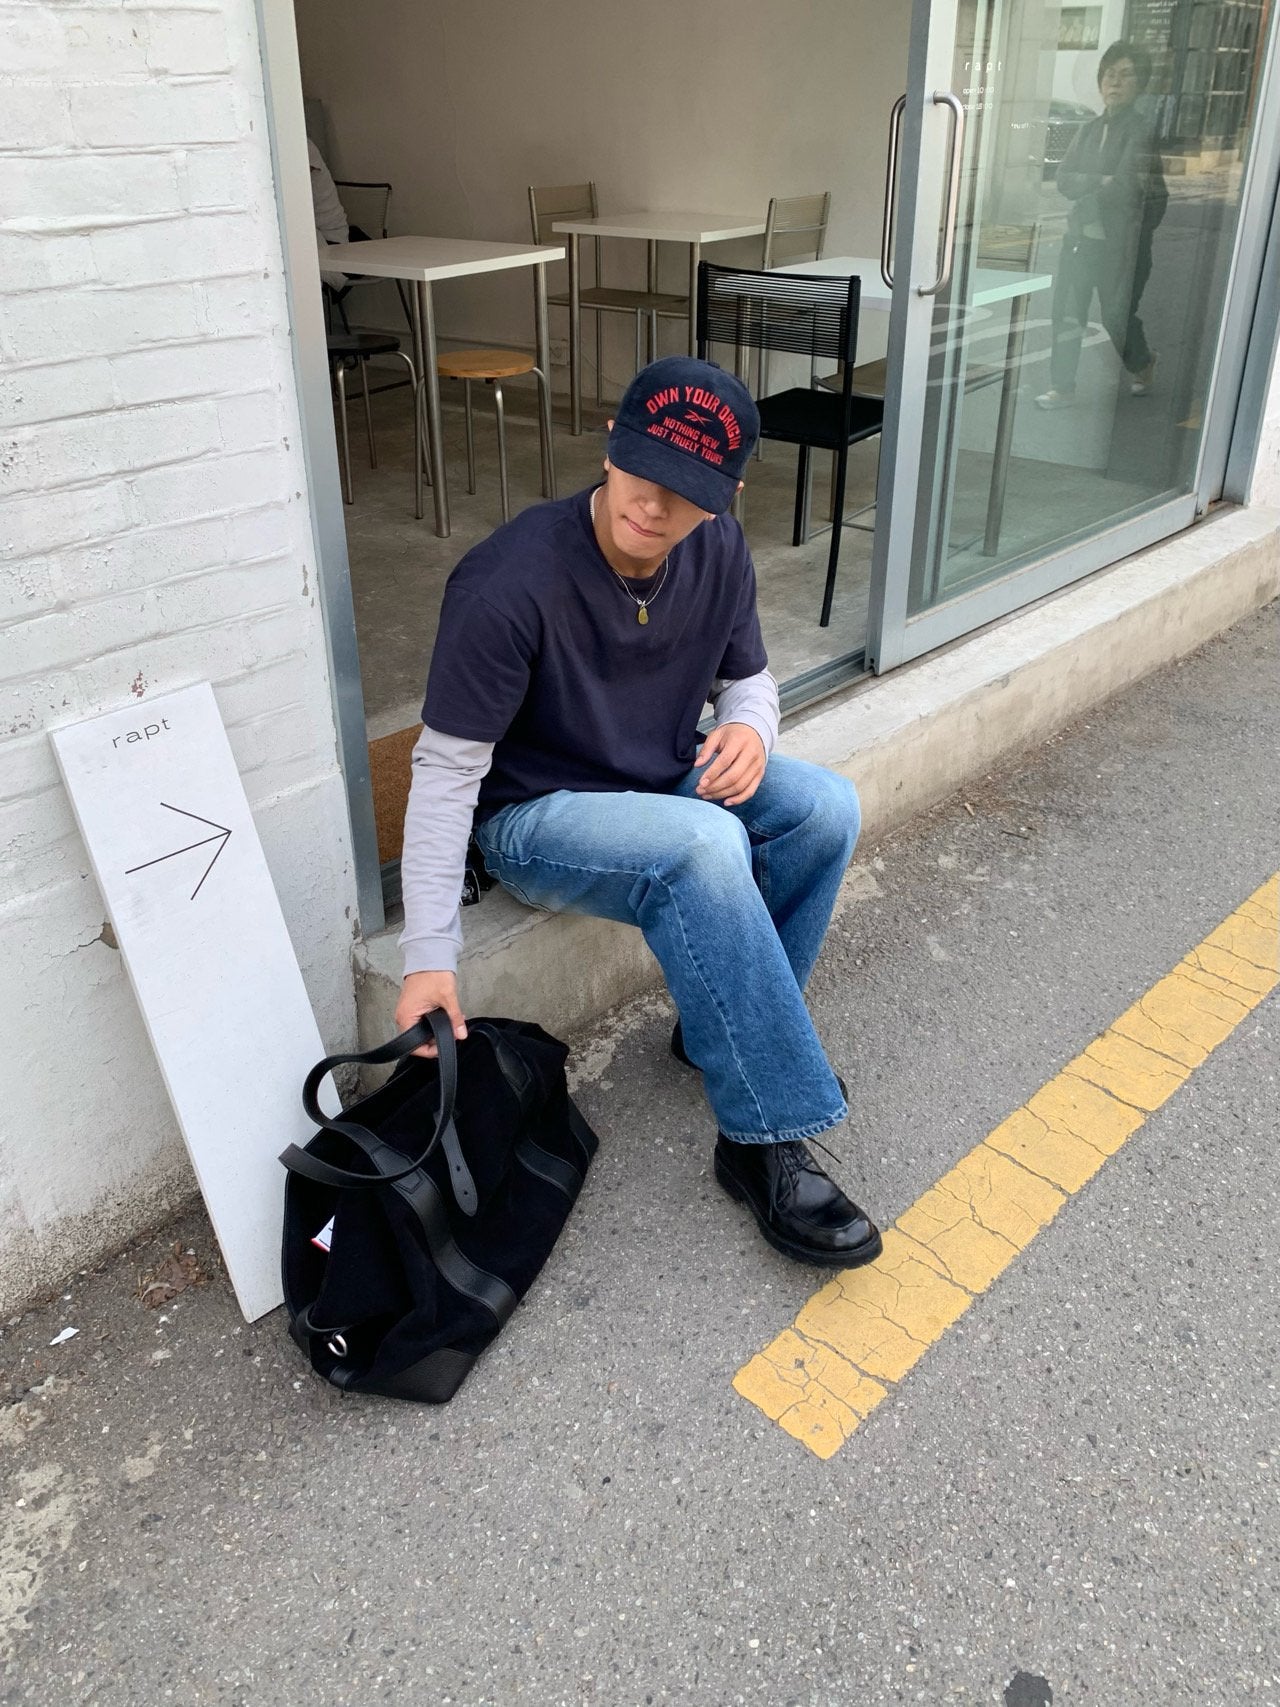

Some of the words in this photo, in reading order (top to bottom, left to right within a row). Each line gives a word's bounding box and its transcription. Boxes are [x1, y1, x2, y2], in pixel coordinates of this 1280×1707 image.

[964, 61, 1002, 73] rapt
[646, 387, 680, 415] OWN
[685, 386, 721, 413] YOUR
[718, 404, 742, 451] ORIGIN
[662, 416, 701, 441] NOTHING
[700, 433, 720, 450] NEW
[647, 424, 669, 439] JUST
[670, 432, 700, 454] TRUELY
[700, 446, 724, 465] YOURS
[111, 718, 171, 749] rapt
